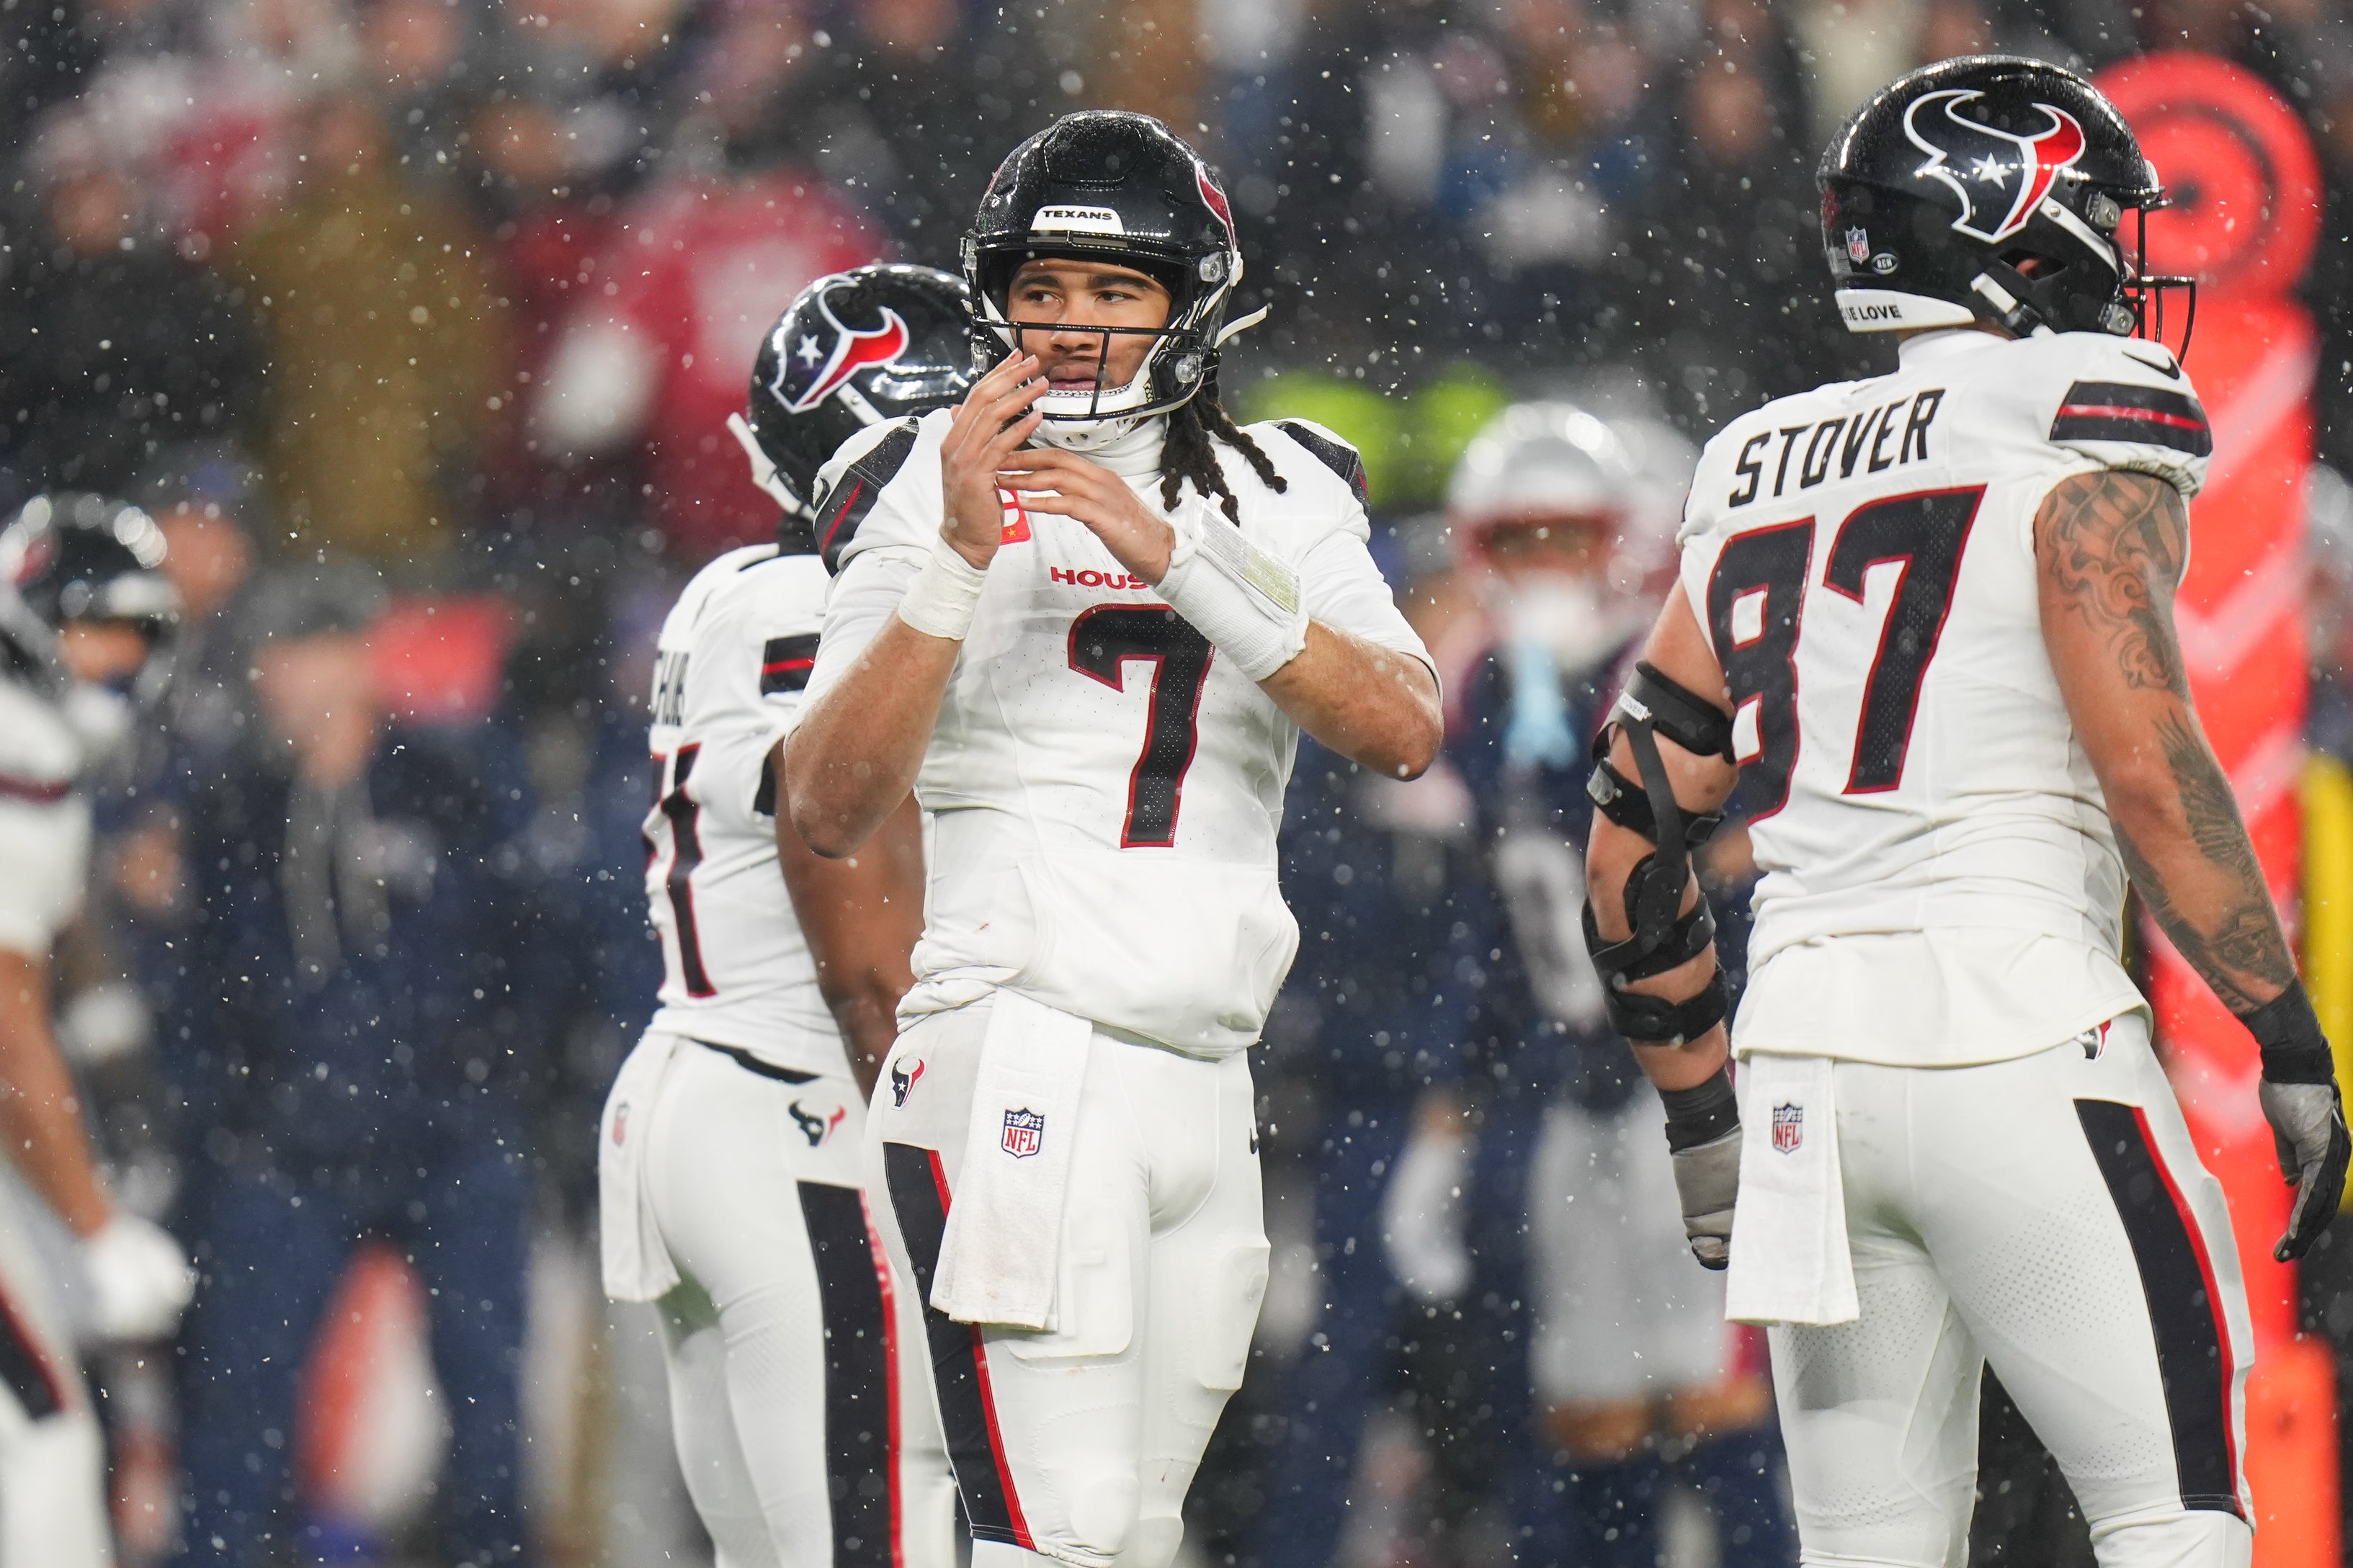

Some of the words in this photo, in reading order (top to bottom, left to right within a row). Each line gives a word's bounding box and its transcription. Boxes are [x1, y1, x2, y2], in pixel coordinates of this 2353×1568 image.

[1042, 210, 1112, 220] TEXANS
[1849, 241, 1867, 257] NFL
[1858, 304, 1903, 320] LOVE
[1729, 387, 1946, 508] STOVER
[1706, 483, 1988, 826] 87
[1067, 603, 1216, 848] 7
[1005, 1128, 1035, 1152] NFL
[1774, 1124, 1800, 1148] NFL
